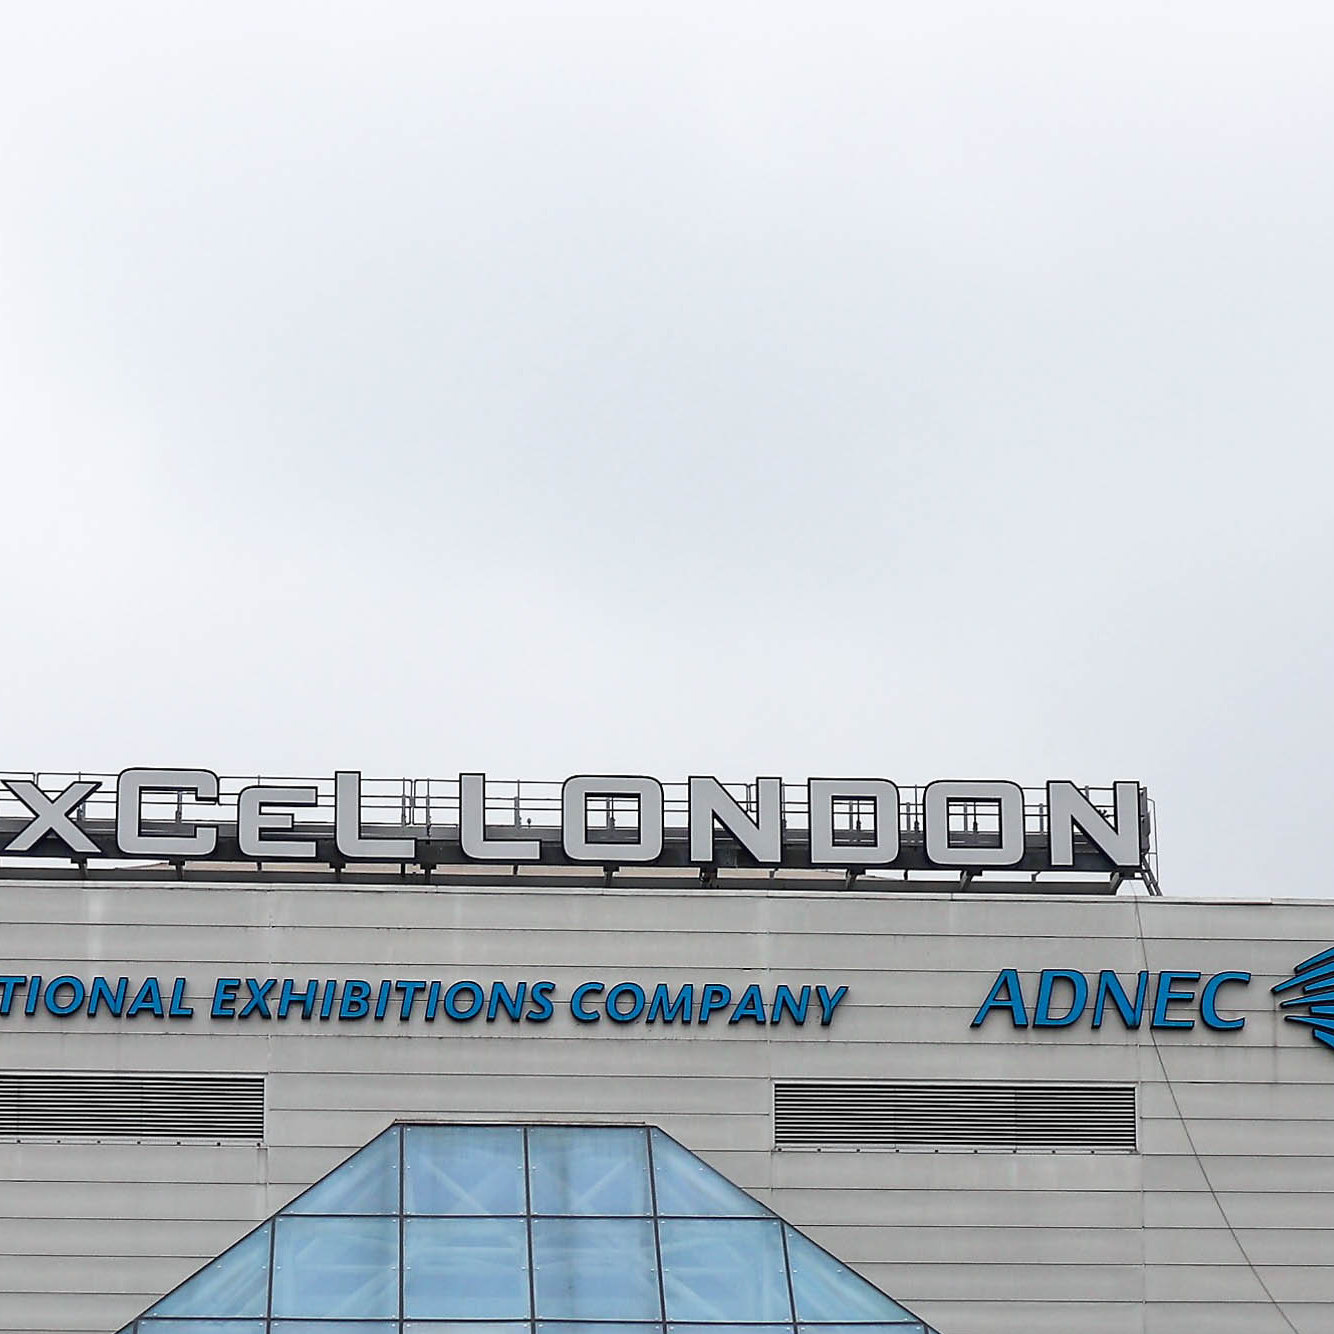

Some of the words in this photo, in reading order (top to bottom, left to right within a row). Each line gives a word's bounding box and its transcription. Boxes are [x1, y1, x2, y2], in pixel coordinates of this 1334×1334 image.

[459, 772, 1139, 868] LONDON
[210, 977, 556, 1021] EXHIBITIONS
[570, 982, 848, 1023] COMPANY
[971, 967, 1252, 1031] ADNEC
